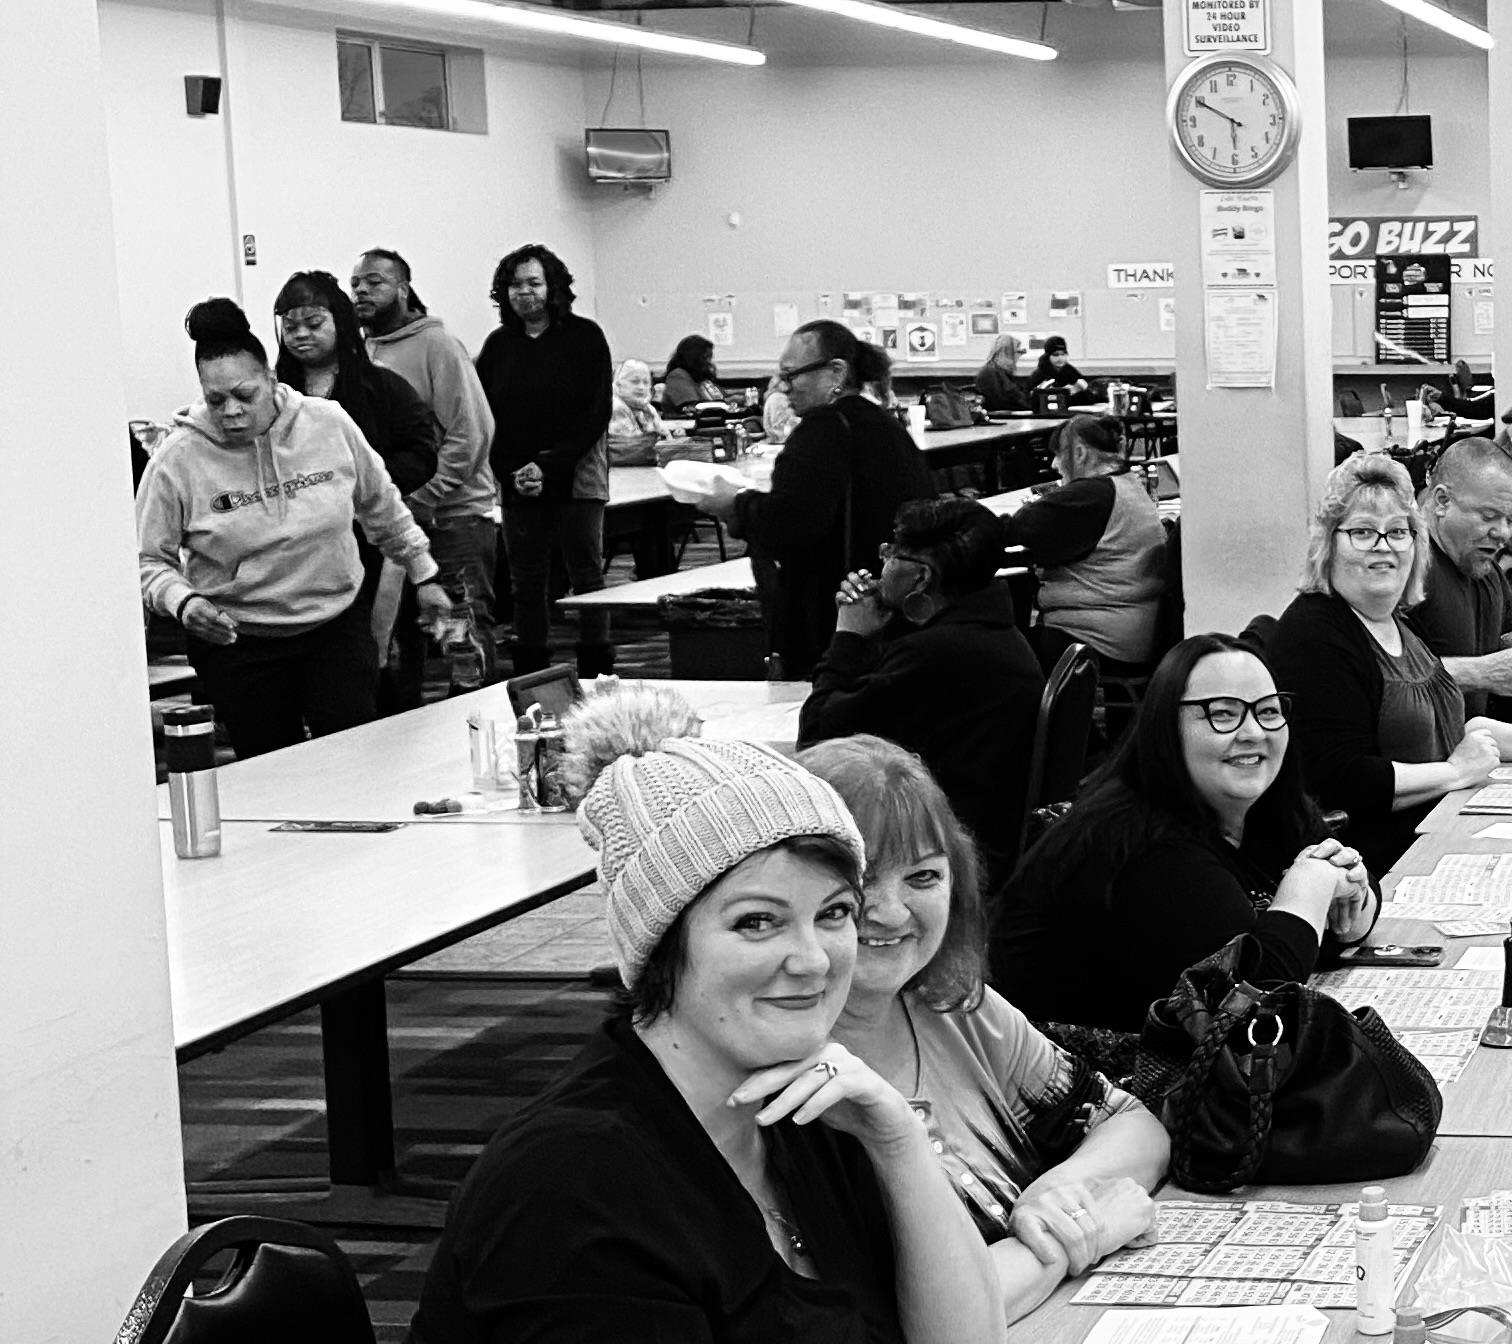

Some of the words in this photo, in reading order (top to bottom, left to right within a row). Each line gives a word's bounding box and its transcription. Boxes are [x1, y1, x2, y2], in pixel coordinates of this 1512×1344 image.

[1192, 0, 1246, 9] MONITORED
[1248, 0, 1260, 9] BY
[1206, 12, 1217, 21] 24
[1220, 11, 1246, 20] HOUR
[1212, 23, 1240, 32] VIDEO
[1194, 34, 1258, 43] SURVEILLANCE
[1376, 221, 1476, 254] BUZZ
